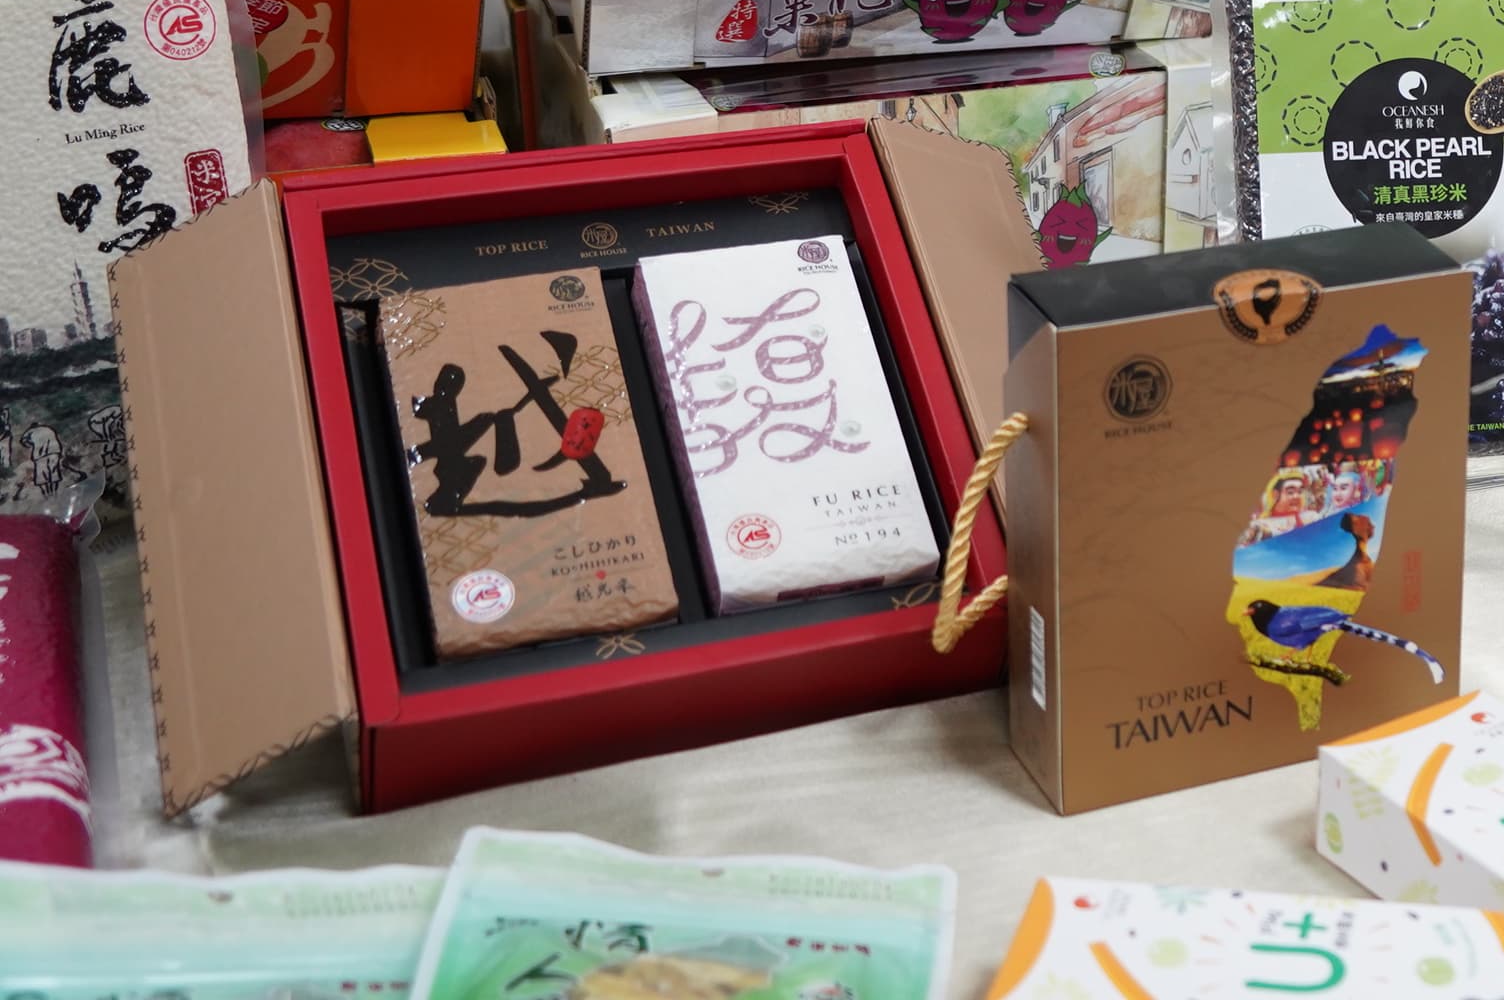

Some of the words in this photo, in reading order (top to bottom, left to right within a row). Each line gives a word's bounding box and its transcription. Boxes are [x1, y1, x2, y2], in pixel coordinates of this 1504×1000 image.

[1382, 104, 1445, 117] OCEANESH
[65, 132, 82, 145] Lu
[85, 126, 117, 142] Ming
[119, 122, 146, 137] Rice
[1332, 138, 1411, 161] BLACK
[1415, 136, 1492, 158] PEARL
[1389, 158, 1442, 180] RICE
[1373, 183, 1467, 205] 清真黑珍米
[645, 221, 716, 239] TAIWAN
[475, 243, 507, 257] TOP
[510, 239, 549, 254] RICE
[579, 250, 599, 259] RICE
[600, 247, 628, 257] HOUSE
[1477, 422, 1504, 431] TAIWAN
[812, 493, 838, 508] FU
[852, 484, 902, 501] RICE
[825, 501, 898, 518] TAIWAN
[553, 535, 637, 562] こしひかり
[551, 552, 645, 578] KOSHIHIKARI
[1137, 690, 1178, 713] TOP
[1183, 679, 1229, 703] RICE
[1105, 695, 1253, 750] TAIWAN
